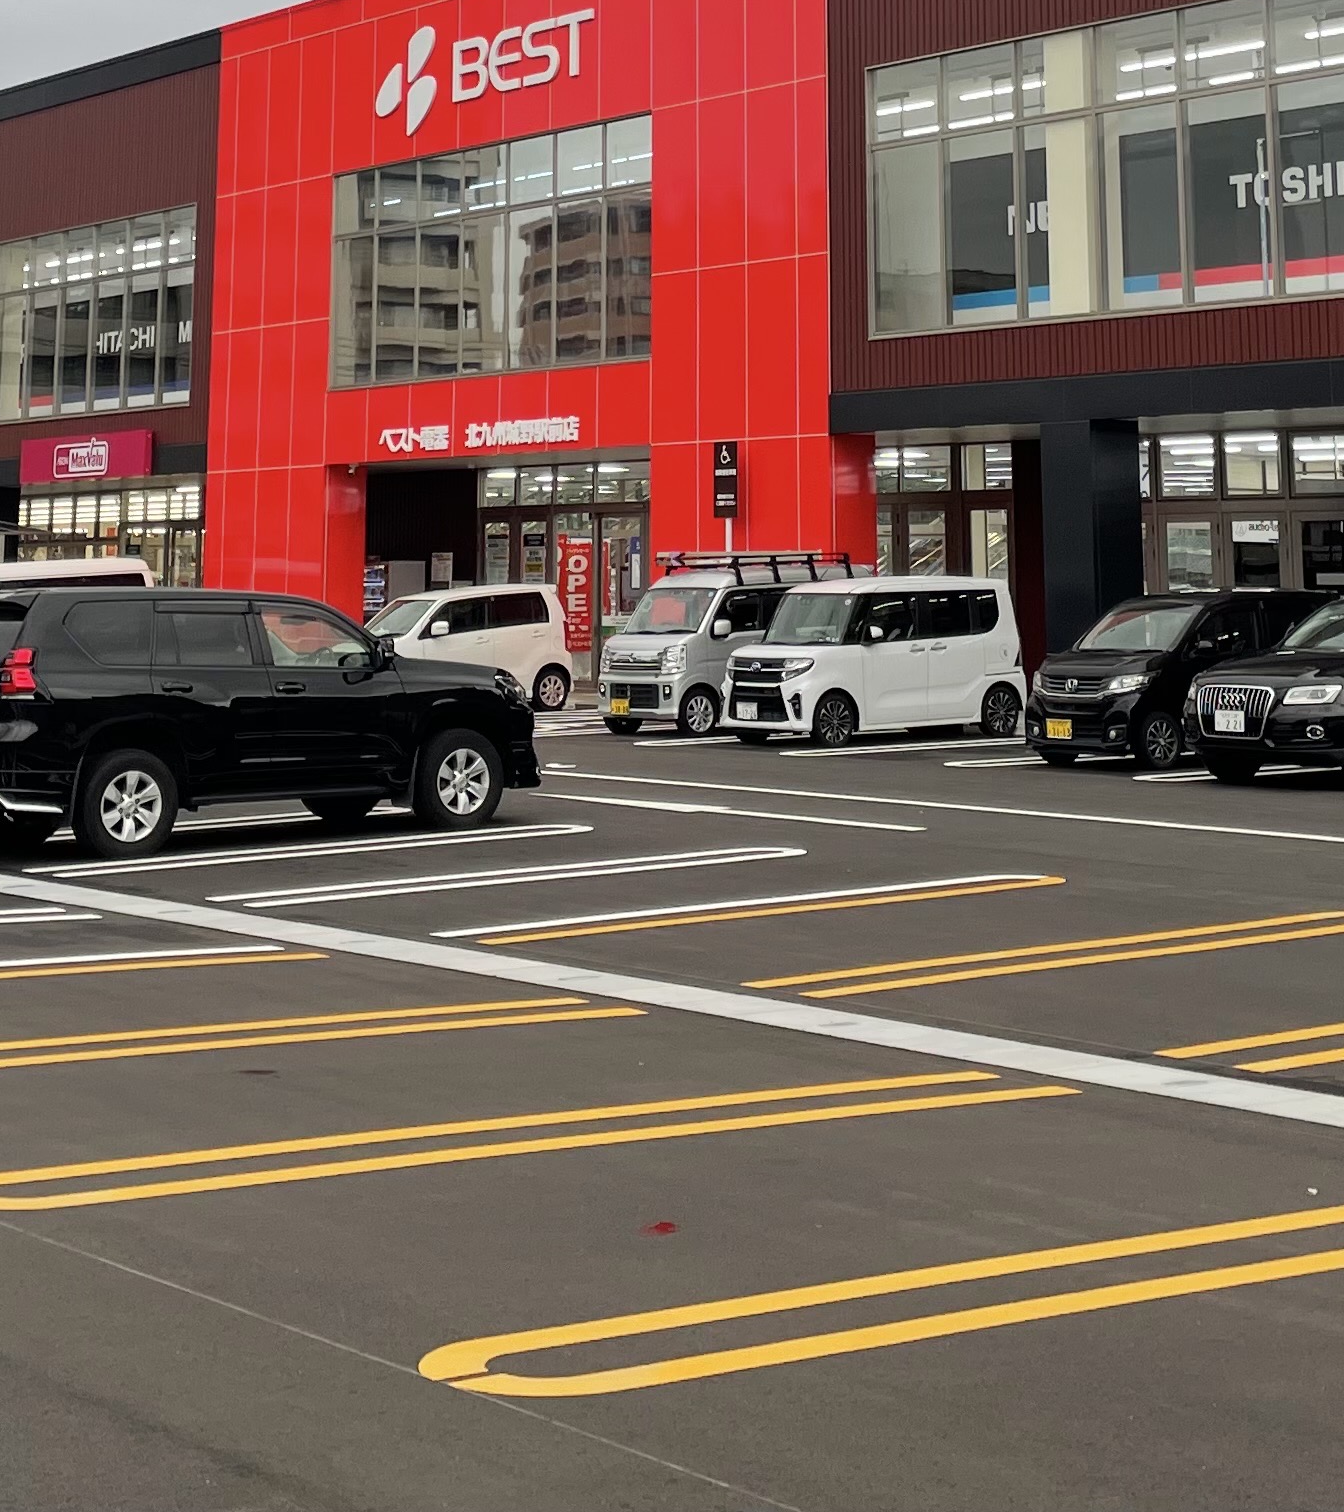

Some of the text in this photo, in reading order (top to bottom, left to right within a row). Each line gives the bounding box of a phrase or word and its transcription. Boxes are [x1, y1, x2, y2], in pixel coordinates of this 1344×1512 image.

[452, 8, 595, 103] BEST
[96, 325, 155, 355] HITACHI
[379, 425, 449, 453] ベスト電器
